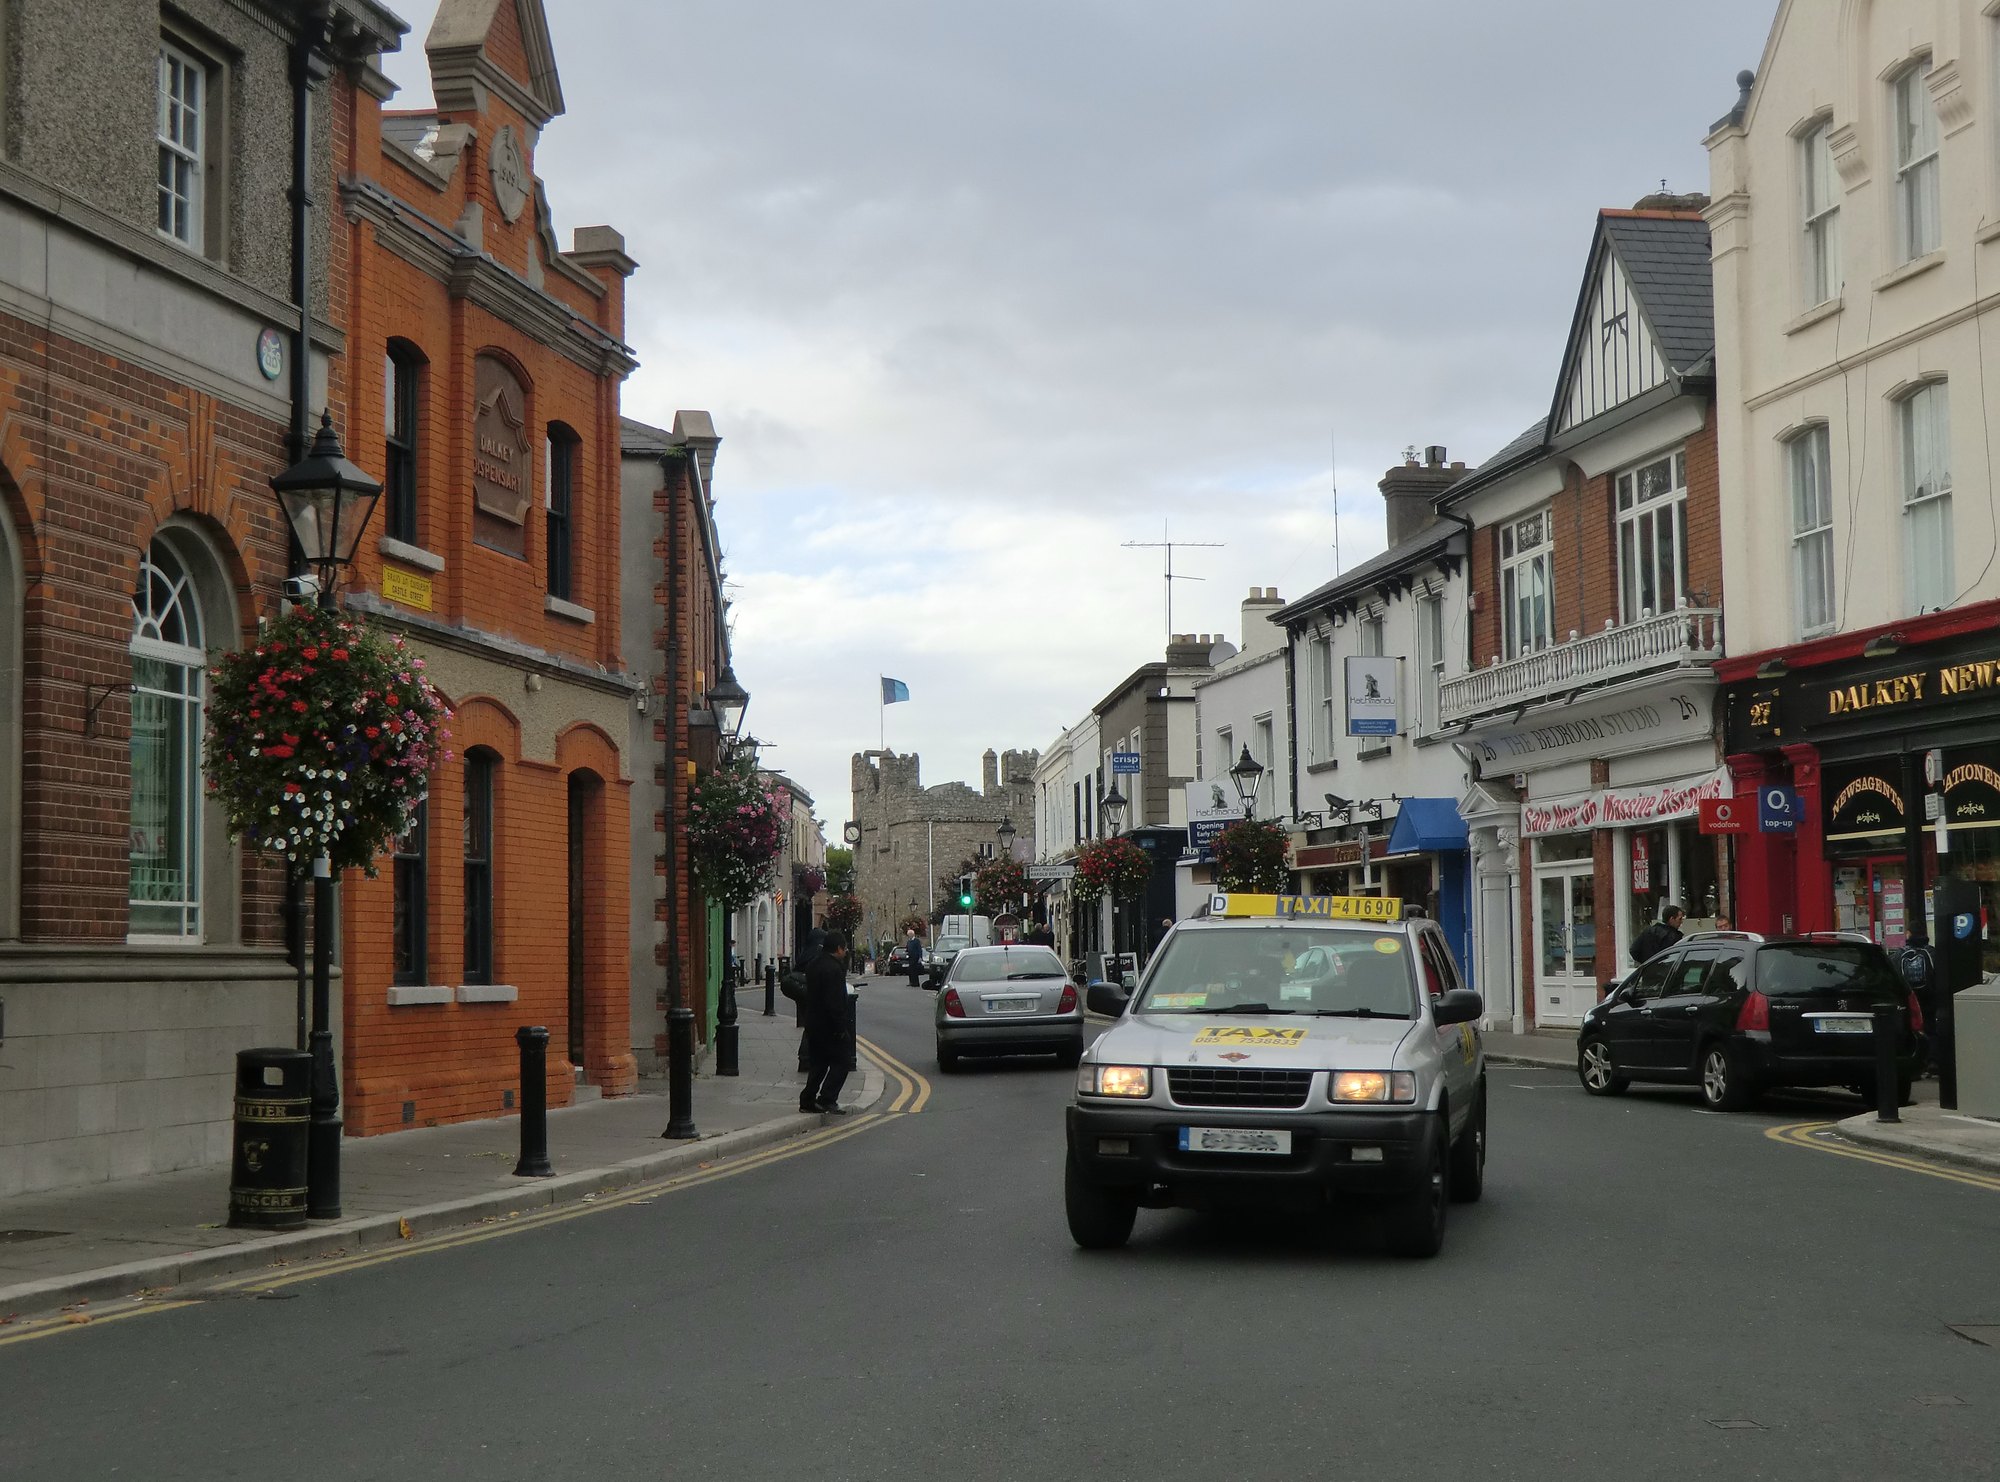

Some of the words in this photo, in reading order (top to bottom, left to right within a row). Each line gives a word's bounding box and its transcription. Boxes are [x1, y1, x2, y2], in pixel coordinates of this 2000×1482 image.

[472, 457, 521, 494] DISPENSARY
[1828, 672, 1927, 714] DALKEY
[1939, 659, 2000, 695] NEW
[1750, 702, 1771, 726] 27
[1475, 741, 1497, 761] 26
[1501, 732, 1536, 756] THE
[1531, 718, 1605, 750] BEDROOM
[1601, 704, 1661, 736] STUDIO
[1670, 694, 1698, 720] 26
[1113, 756, 1138, 764] crisp
[1767, 789, 1790, 813] O2
[1832, 776, 1904, 822] NEWSAGENTS
[1525, 807, 1551, 832] Sale
[1552, 804, 1581, 829] Now
[1580, 799, 1597, 824] On
[1602, 794, 1657, 822] Massive
[1196, 822, 1225, 831] Opening
[1765, 820, 1793, 828] top-up
[1633, 859, 1649, 870] PRICE
[1634, 869, 1649, 889] SALE
[1213, 896, 1227, 912] D
[1280, 897, 1330, 914] TAXI
[1205, 1027, 1305, 1039] TAXI
[1240, 1037, 1299, 1045] 7538833
[237, 1105, 287, 1118] LITTER
